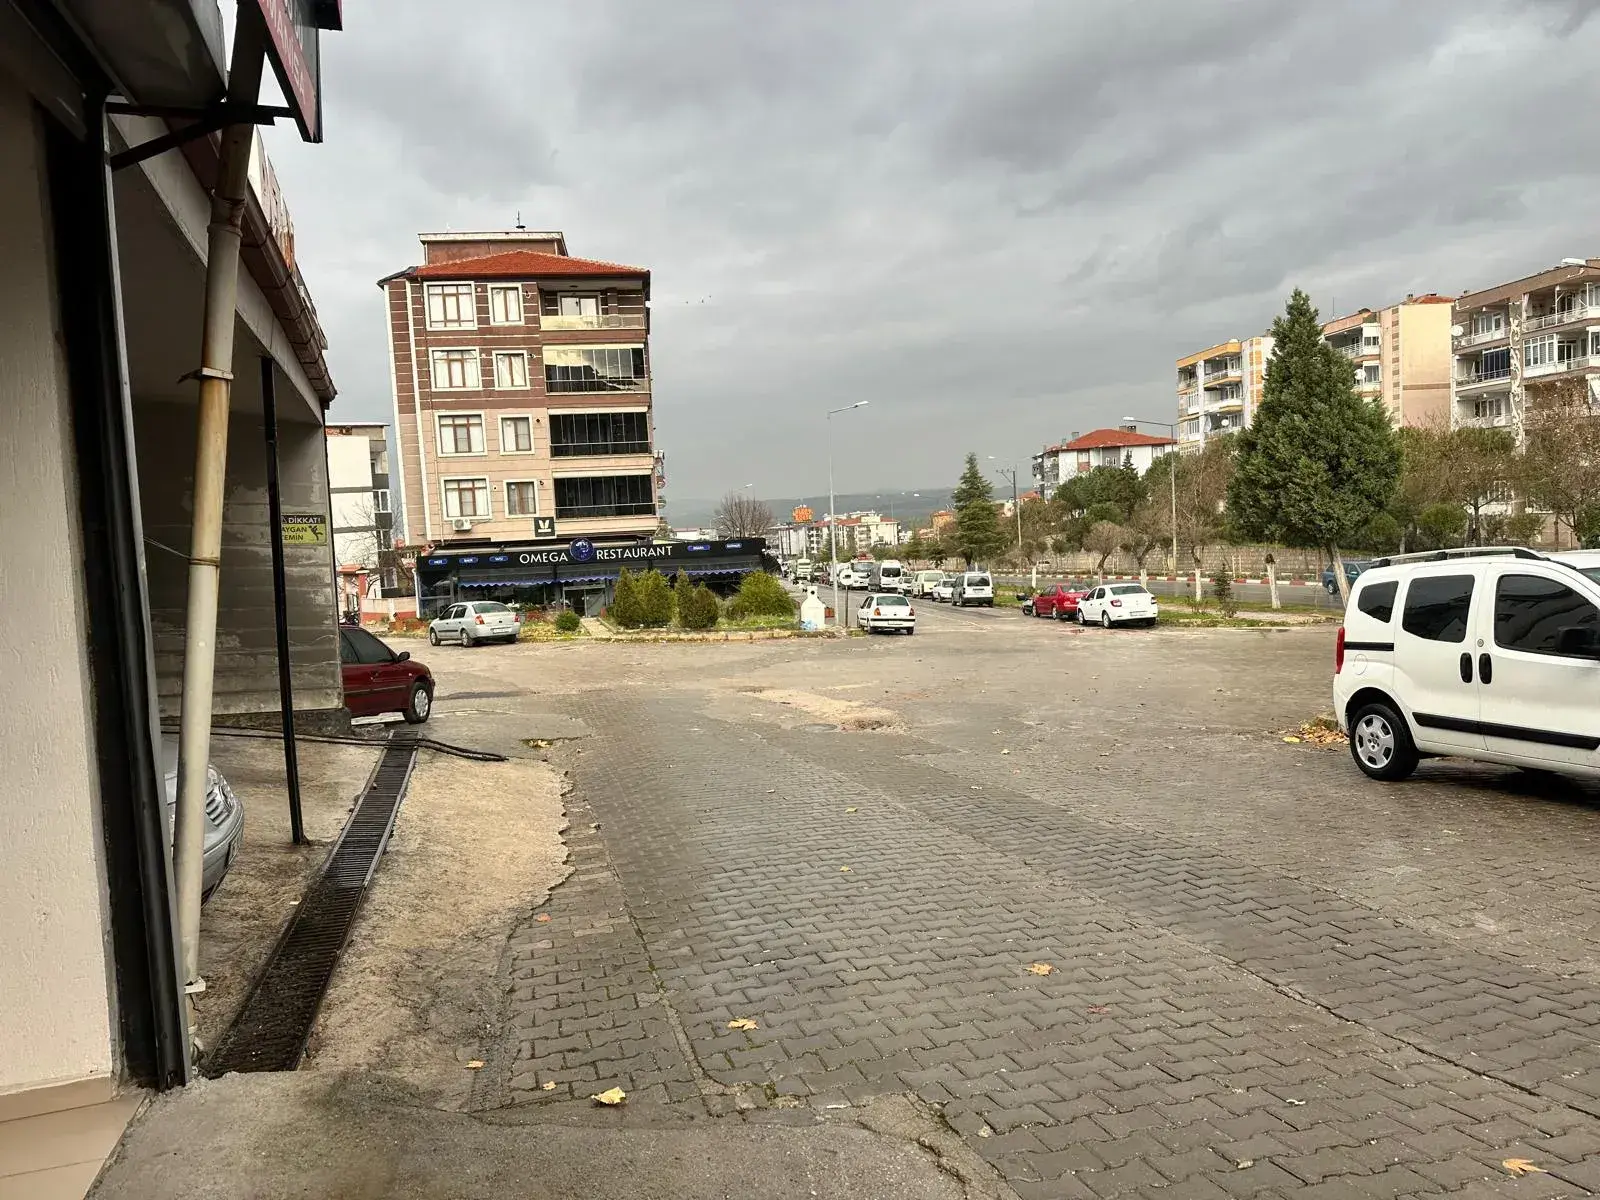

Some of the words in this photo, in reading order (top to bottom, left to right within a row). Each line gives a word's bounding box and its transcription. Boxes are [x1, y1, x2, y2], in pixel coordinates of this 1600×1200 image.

[288, 516, 321, 524] DİKKAT!
[282, 533, 304, 541] EMİN
[519, 552, 568, 564] OMEGA
[596, 546, 673, 560] RESTAURANT
